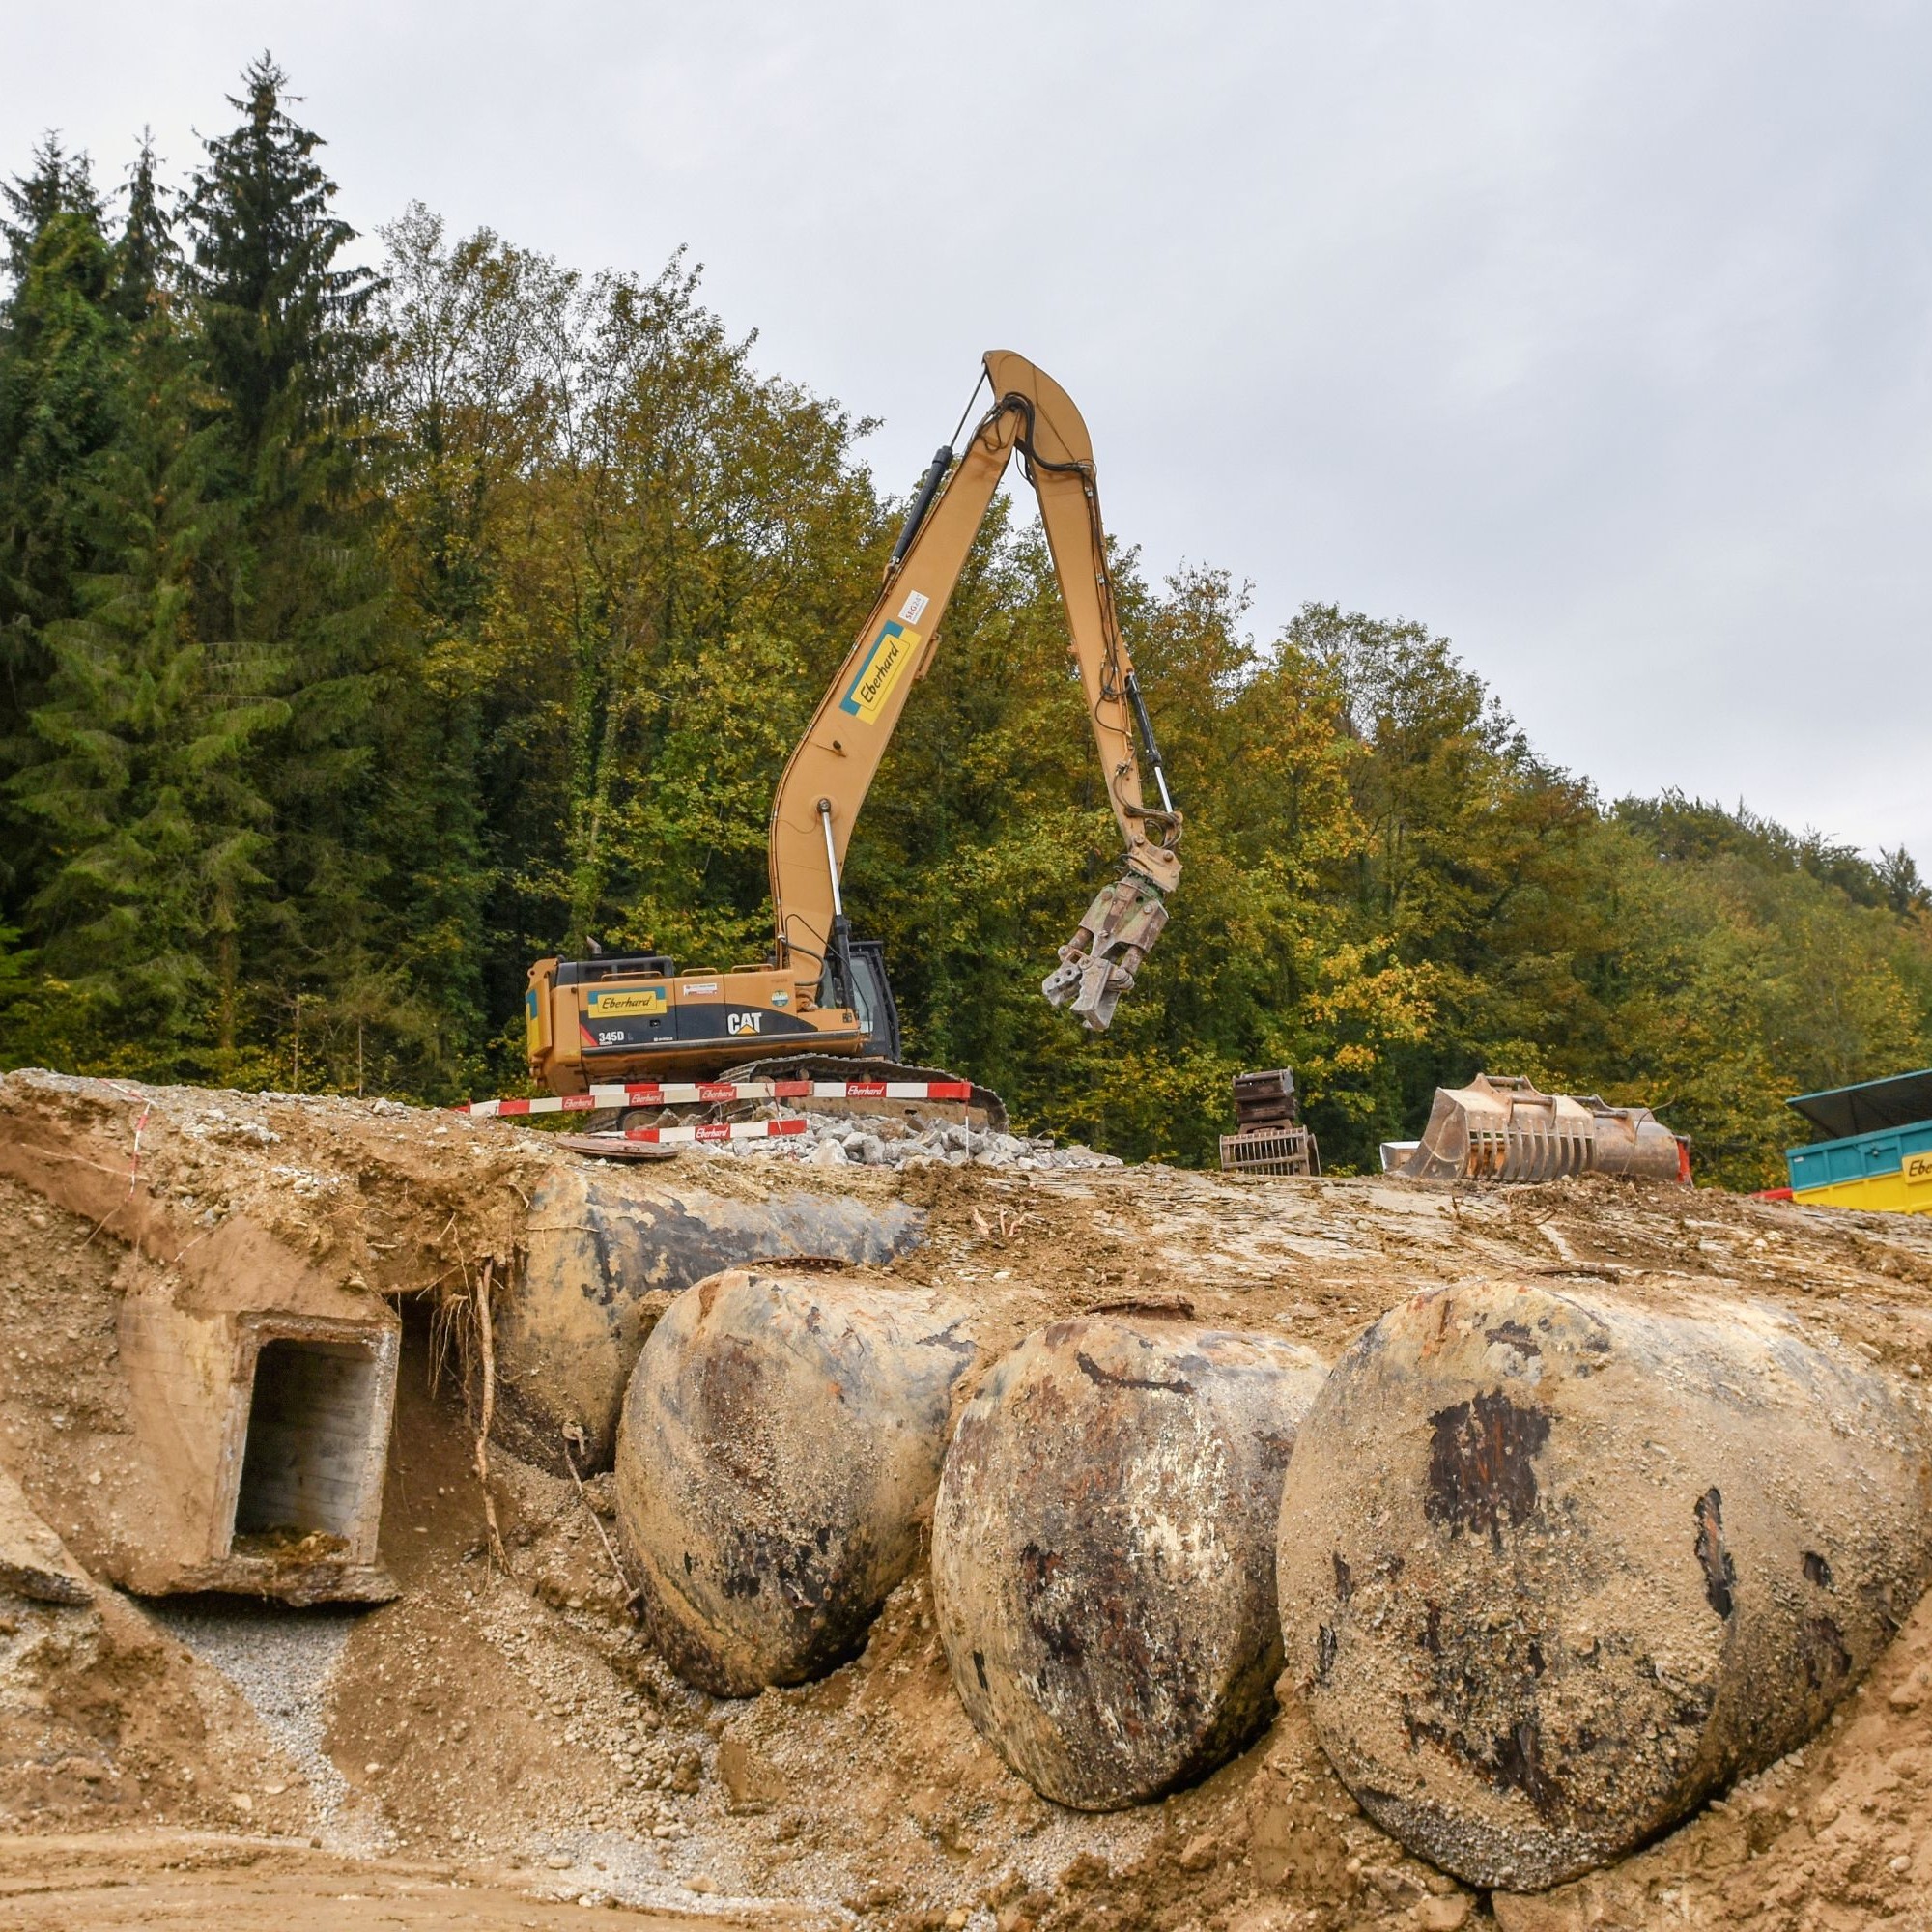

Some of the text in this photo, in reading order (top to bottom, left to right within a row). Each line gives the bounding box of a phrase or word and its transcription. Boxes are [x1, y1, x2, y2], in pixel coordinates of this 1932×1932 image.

[861, 640, 899, 703] Eberhard
[602, 996, 652, 1009] Eberhard
[727, 1012, 762, 1035] CAT
[599, 1031, 624, 1042] 345D
[702, 1090, 734, 1099] Eberhard
[848, 1085, 884, 1095] Eberhard
[564, 1097, 593, 1108] Eberhard
[632, 1094, 662, 1104] Eberhard
[696, 1127, 728, 1138] Eberhard
